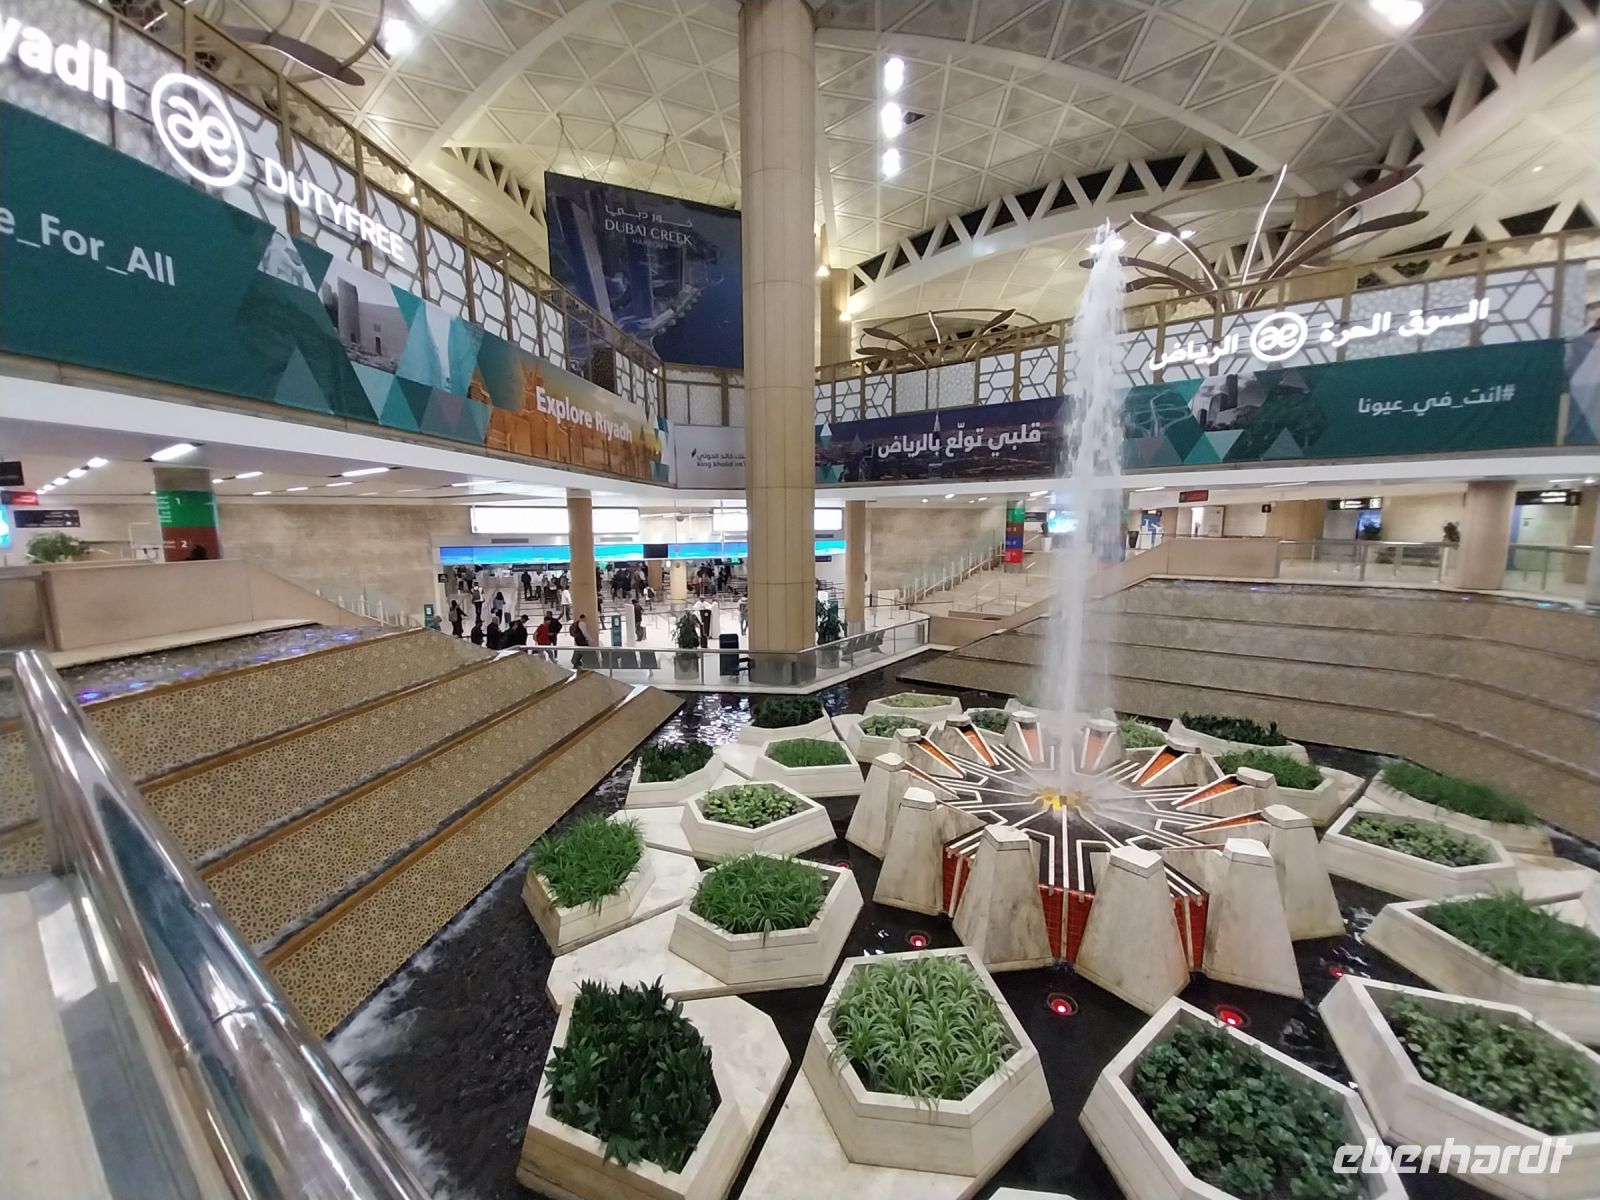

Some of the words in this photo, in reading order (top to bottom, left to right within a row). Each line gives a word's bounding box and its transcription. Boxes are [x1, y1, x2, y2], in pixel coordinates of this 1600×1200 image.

[605, 219, 647, 237] DUBAI
[650, 227, 693, 247] CREEK
[1320, 311, 1391, 348] الحرة
[1399, 298, 1490, 337] السوق
[1149, 333, 1239, 370] الرياض
[536, 385, 593, 429] Explore
[595, 411, 633, 443] Riyadh
[878, 432, 940, 458] بالرياض
[987, 422, 1041, 457] قلبي
[181, 540, 188, 549] 2
